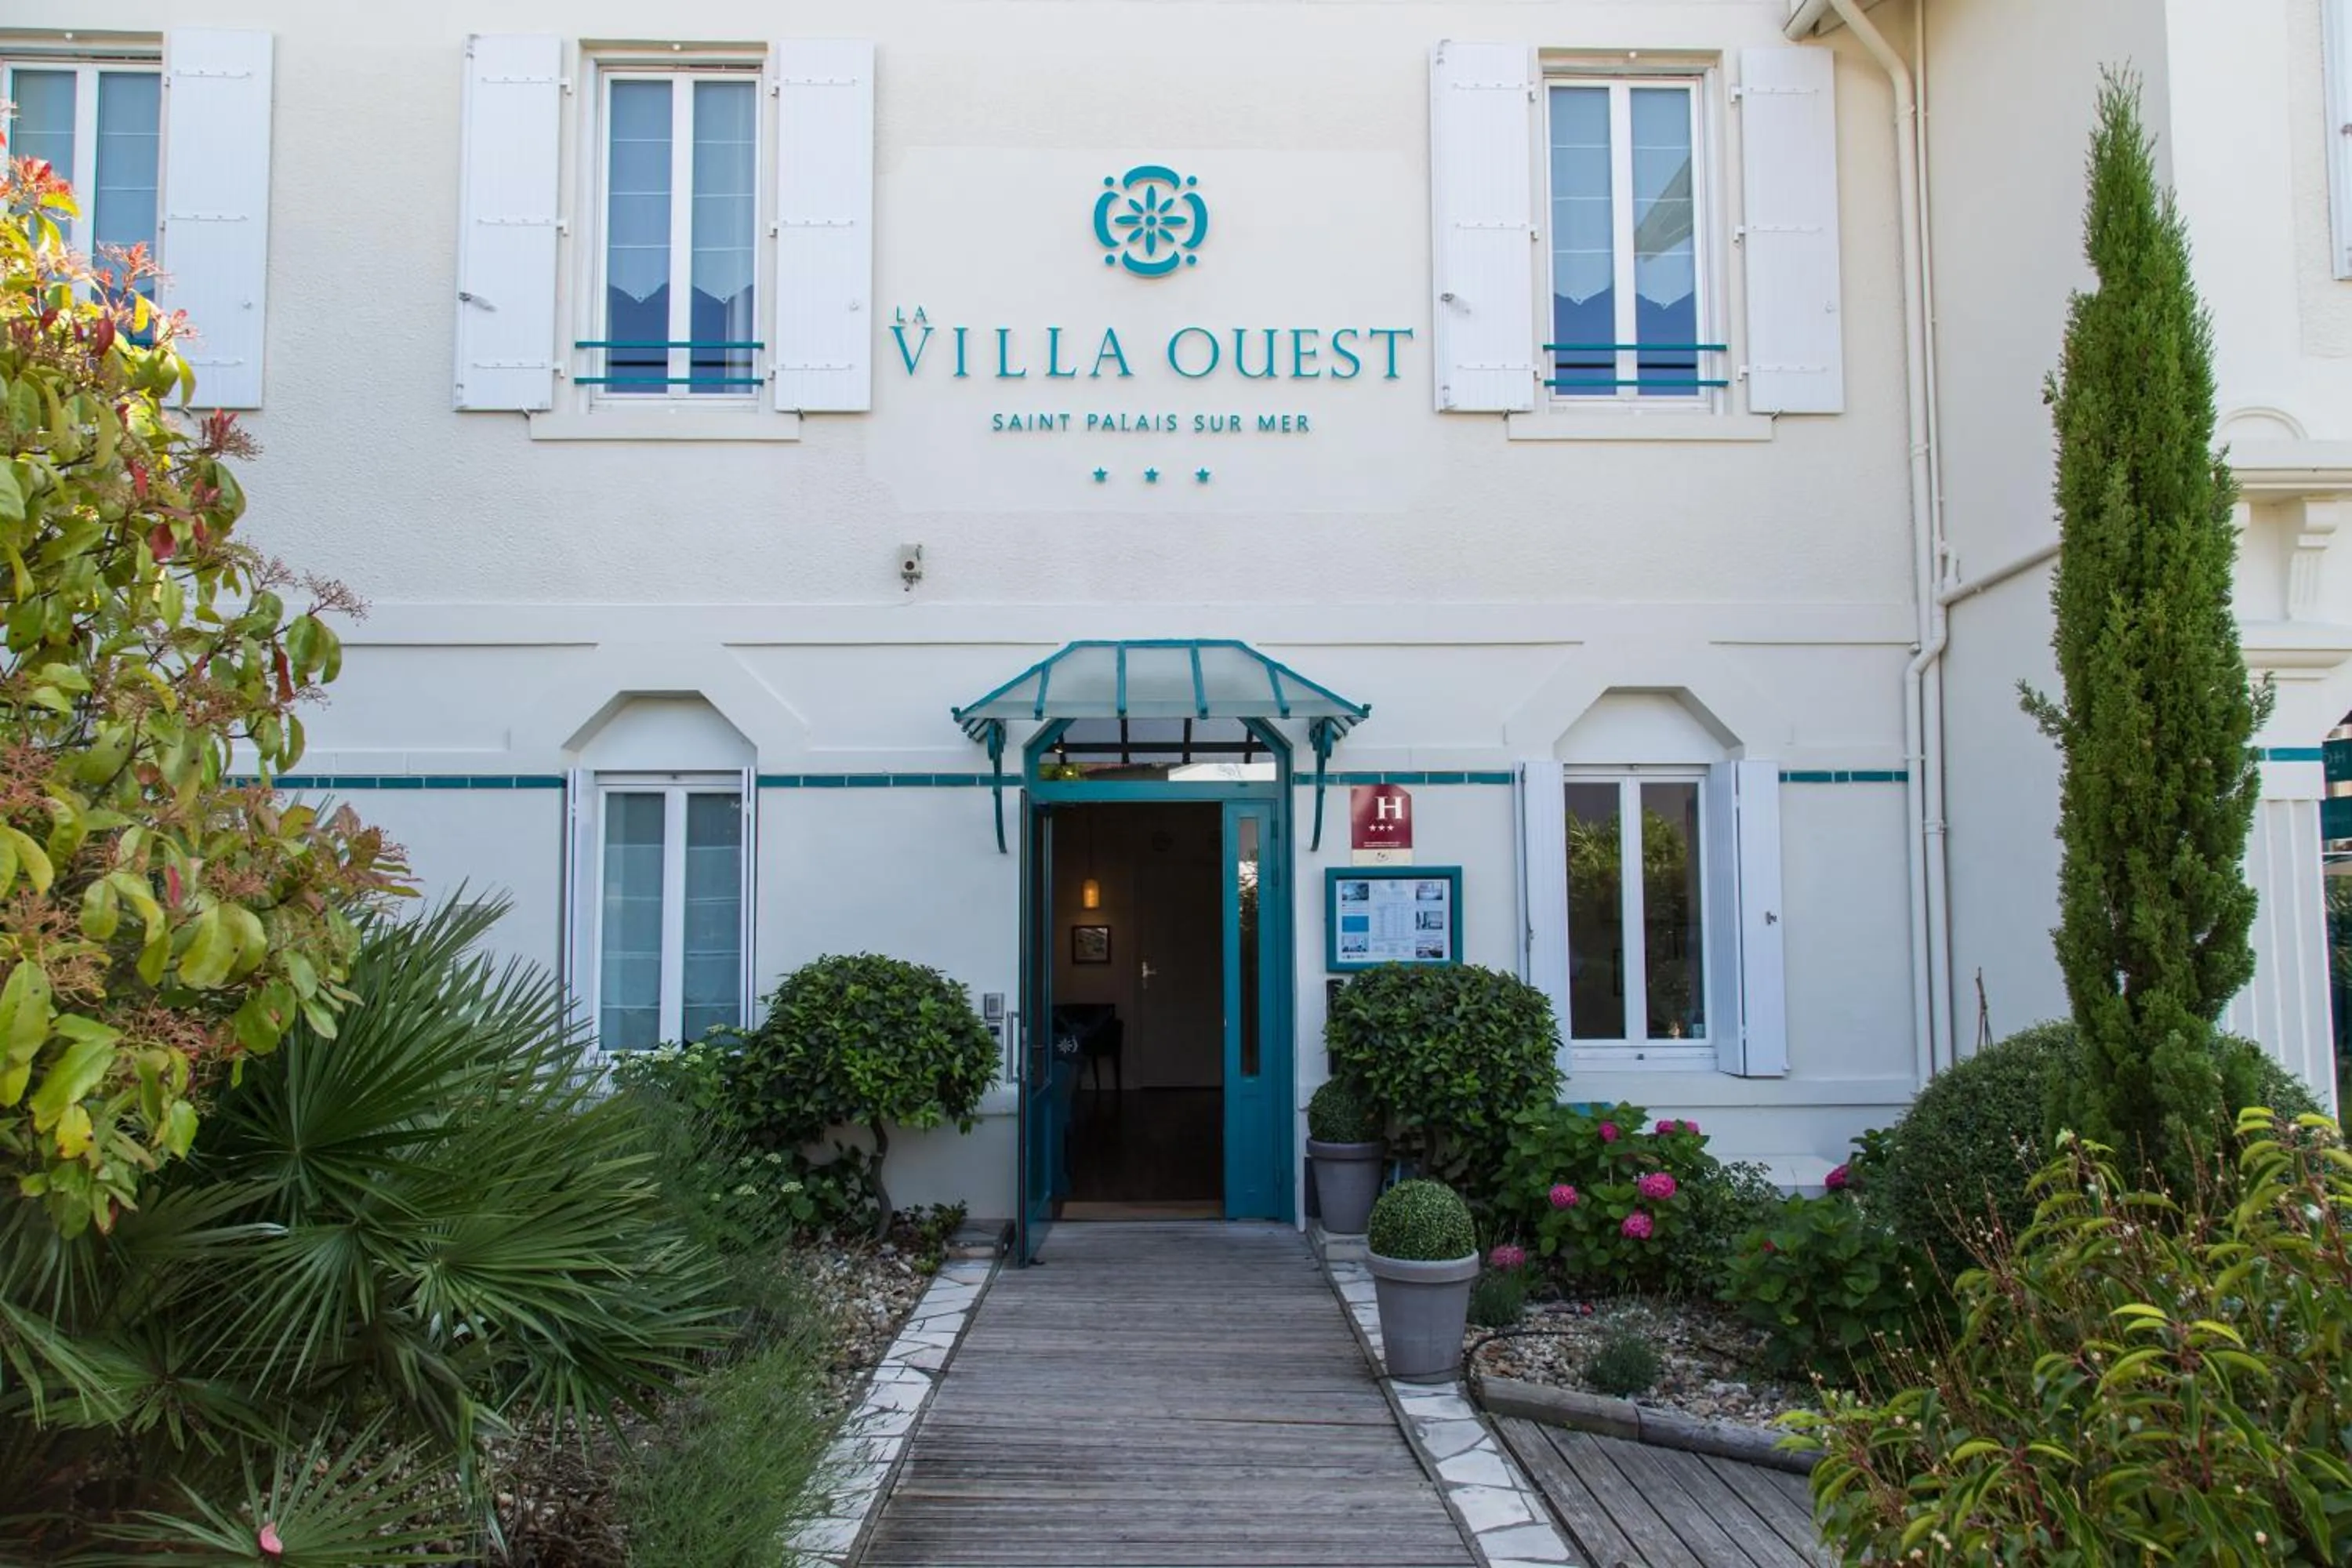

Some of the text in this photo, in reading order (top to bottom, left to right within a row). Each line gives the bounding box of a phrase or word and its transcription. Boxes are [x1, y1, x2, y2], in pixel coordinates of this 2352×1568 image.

[896, 305, 928, 322] LA
[888, 325, 1416, 380] VILLA OUEST
[992, 412, 1311, 433] SAINT PALAIS SUR MER
[1375, 796, 1403, 819] H
